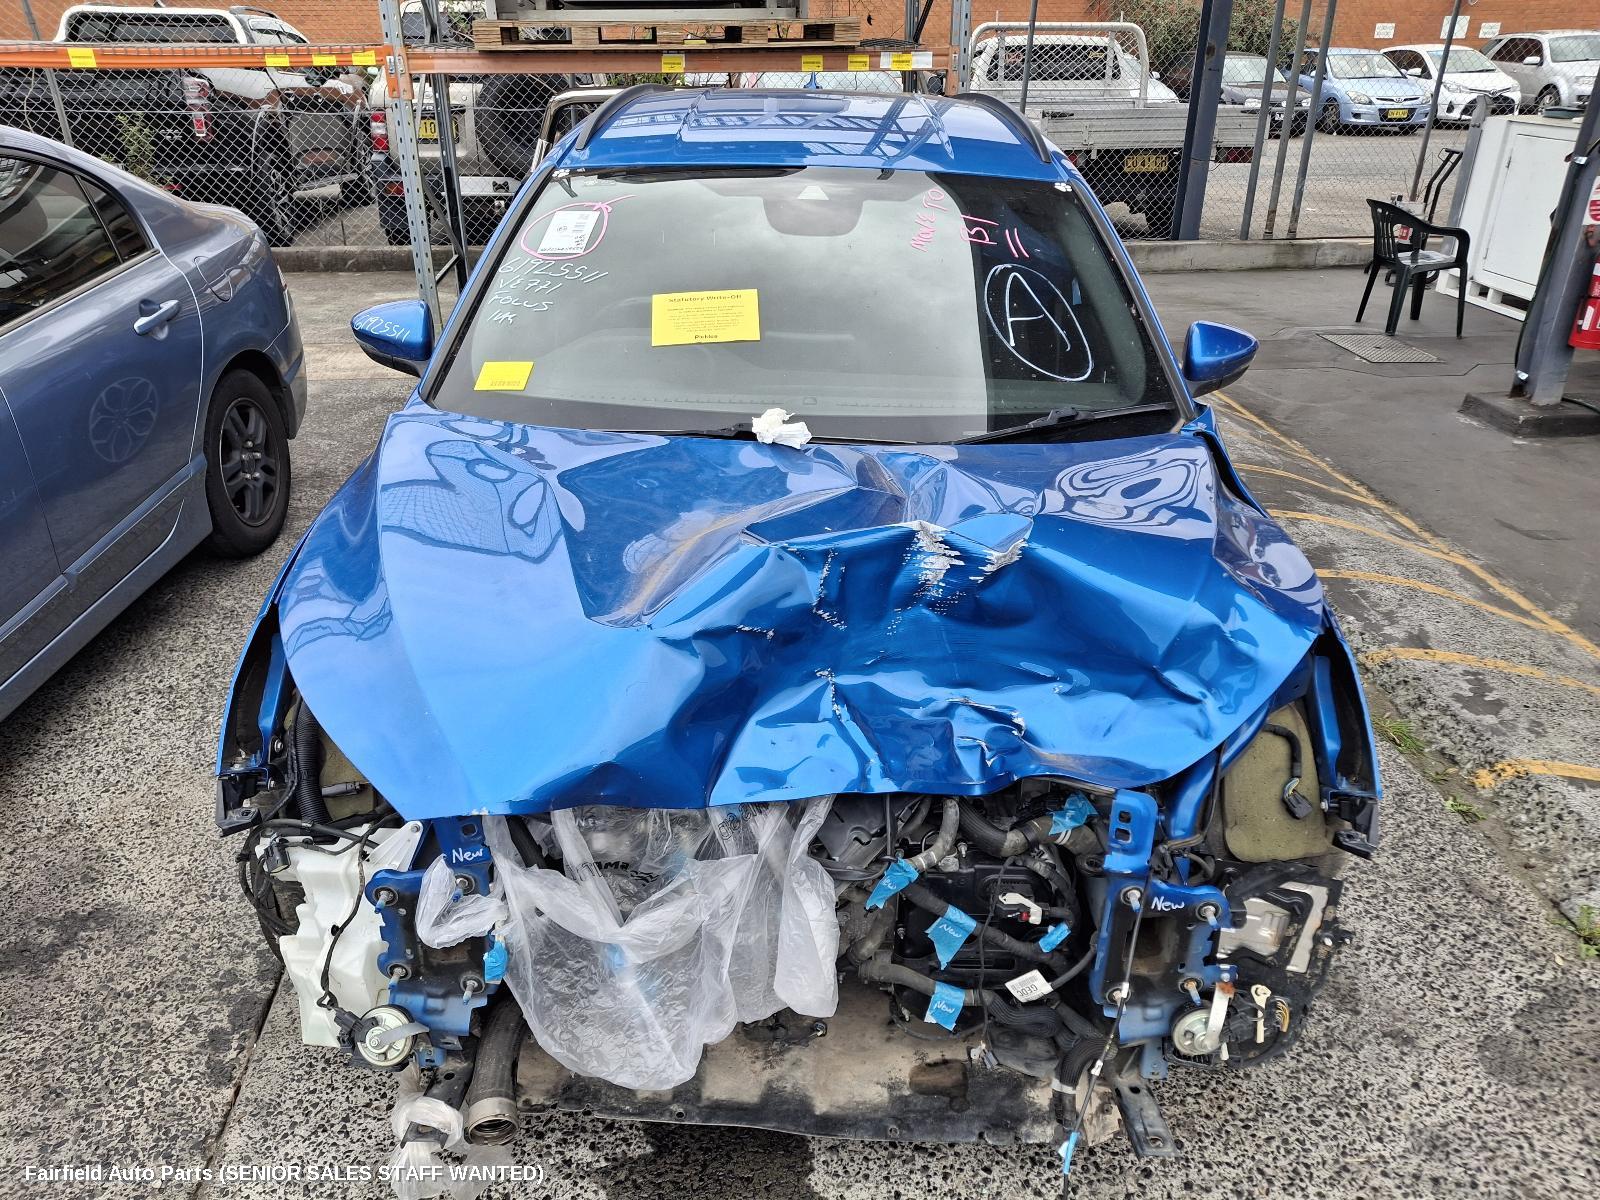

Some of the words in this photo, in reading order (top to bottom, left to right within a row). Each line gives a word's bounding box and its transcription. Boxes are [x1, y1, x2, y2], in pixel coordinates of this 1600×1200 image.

[1005, 272, 1072, 352] A
[452, 848, 484, 864] New
[1151, 896, 1185, 911] New
[939, 923, 962, 938] New
[933, 1001, 956, 1014] New
